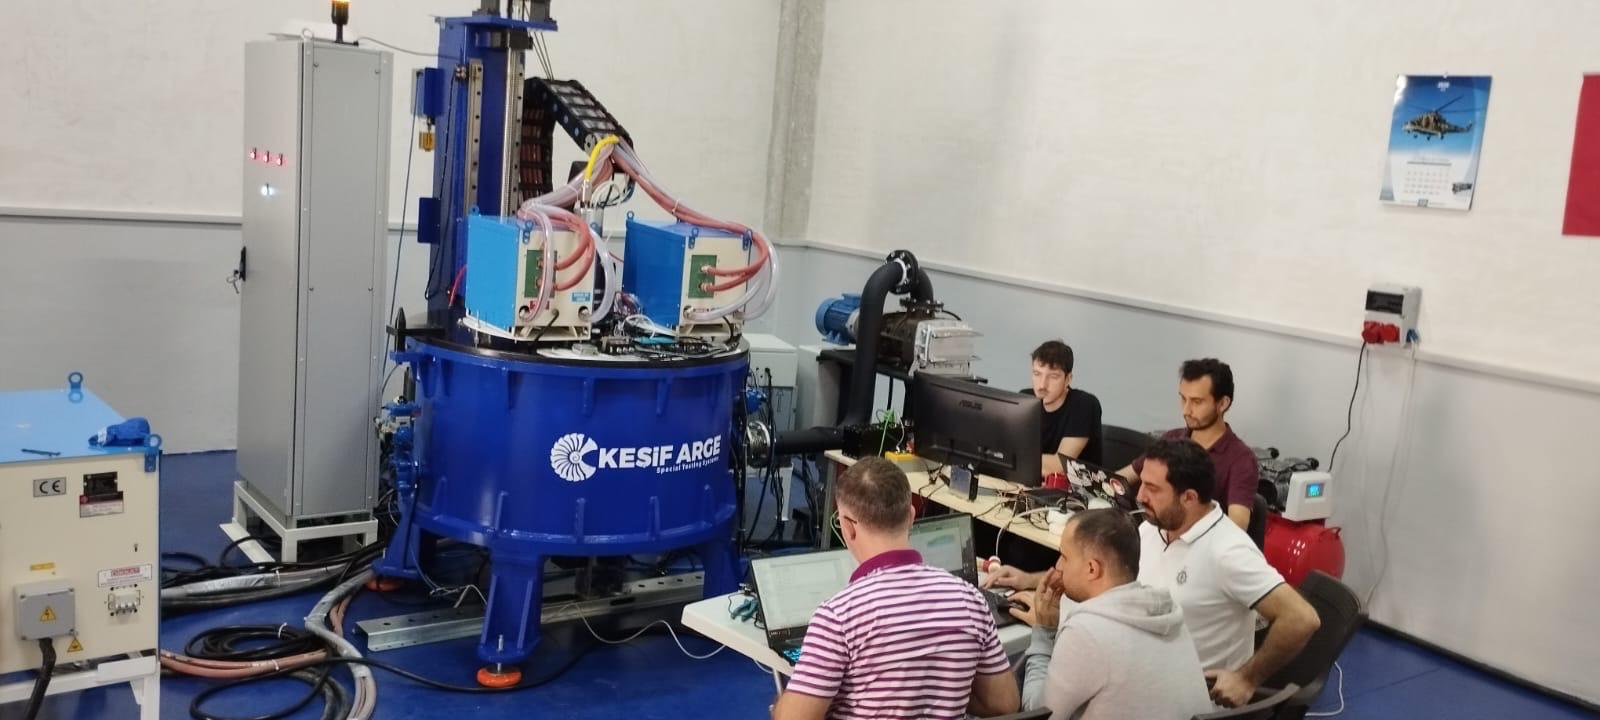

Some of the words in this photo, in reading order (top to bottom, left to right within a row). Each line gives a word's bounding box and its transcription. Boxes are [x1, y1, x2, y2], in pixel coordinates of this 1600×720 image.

[959, 399, 983, 411] ASUS
[676, 434, 722, 465] ARGE
[656, 464, 681, 475] Special
[39, 480, 61, 494] CE
